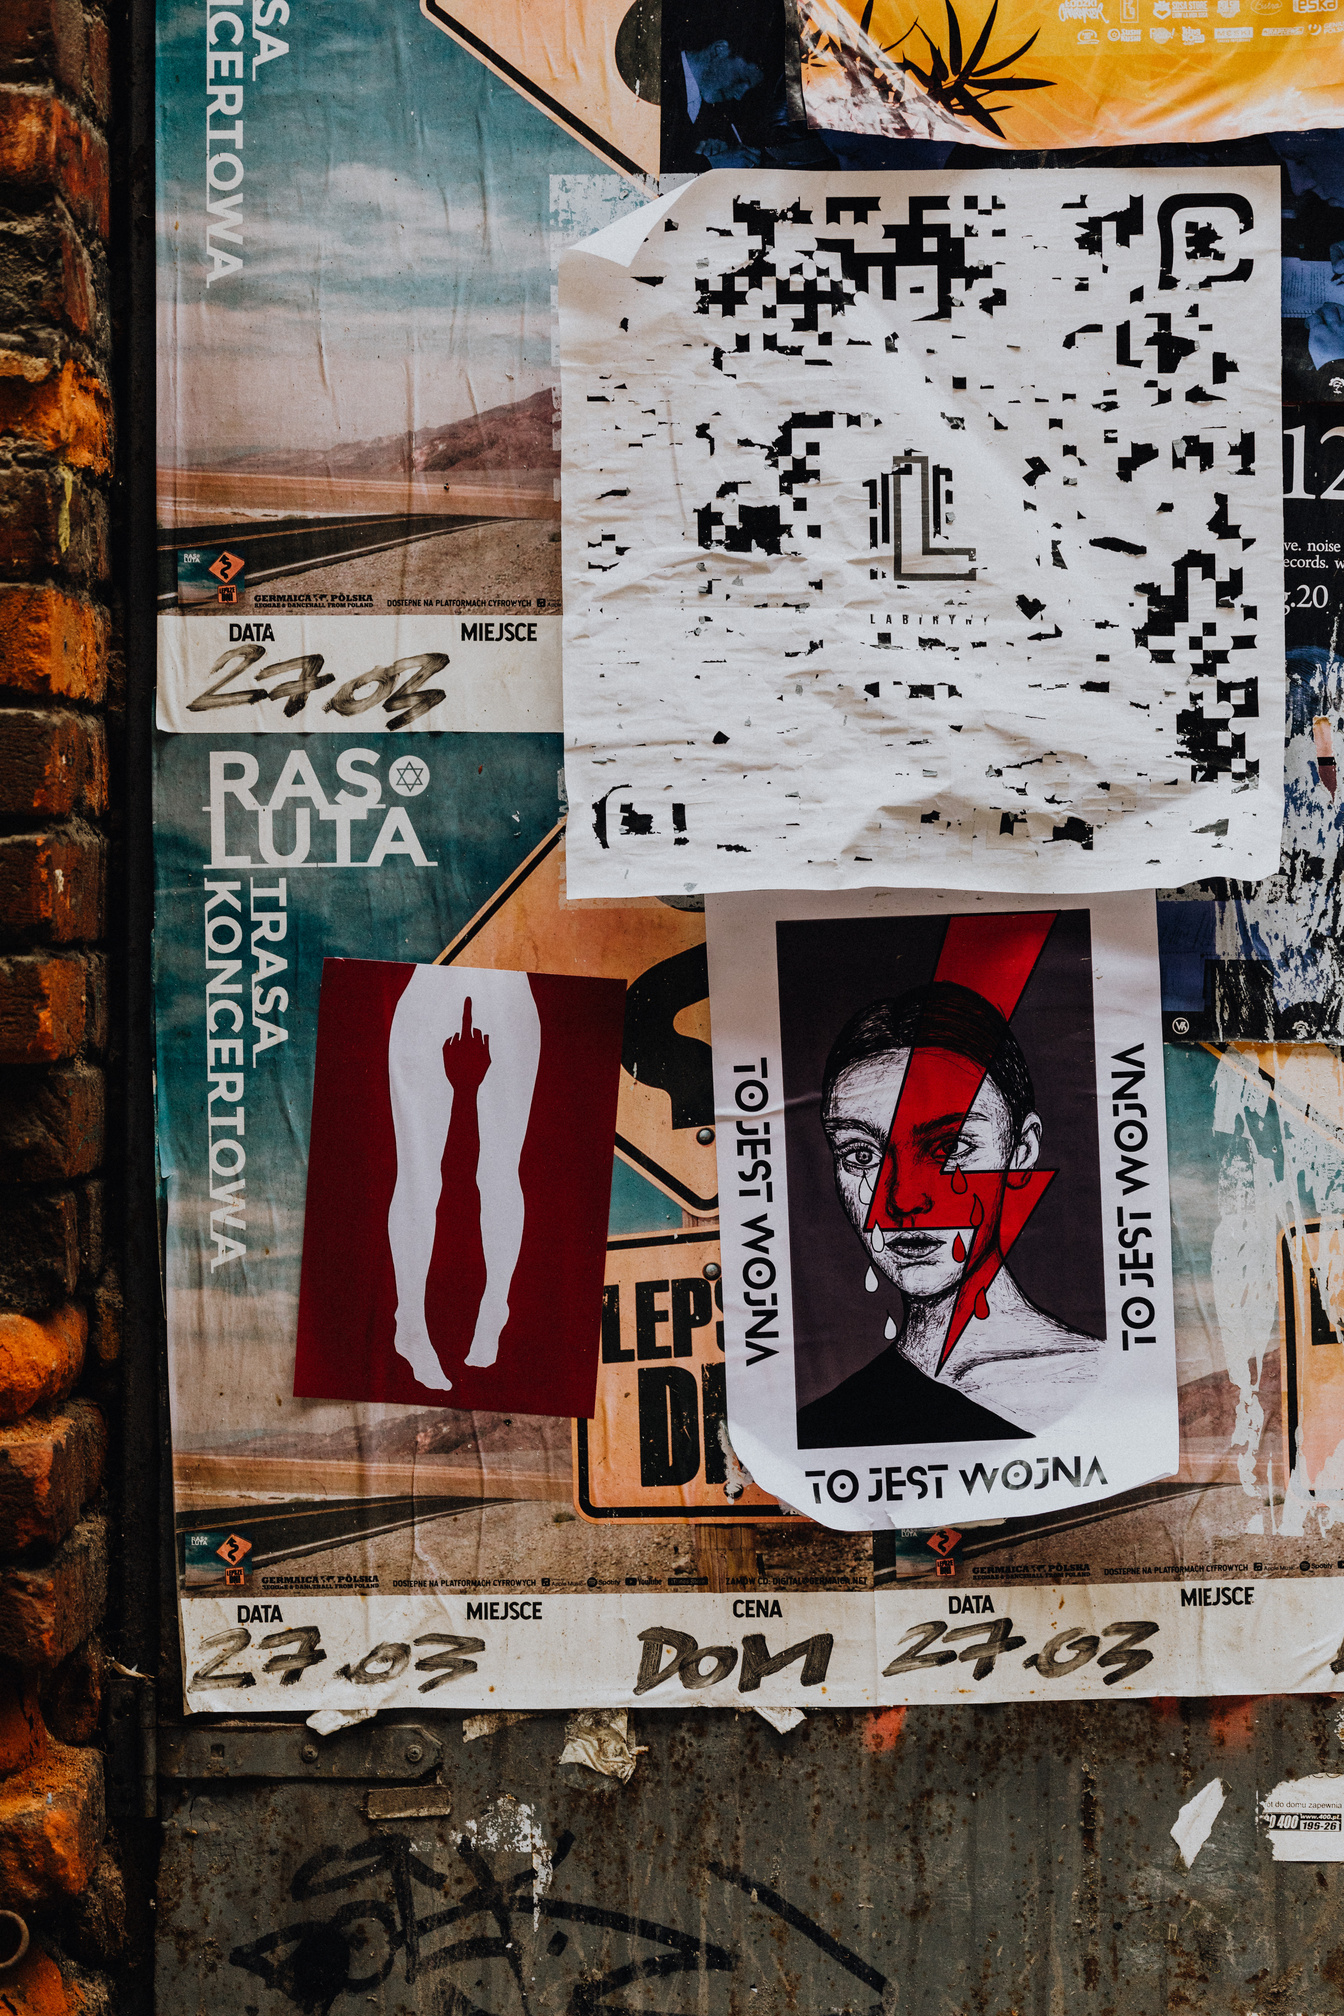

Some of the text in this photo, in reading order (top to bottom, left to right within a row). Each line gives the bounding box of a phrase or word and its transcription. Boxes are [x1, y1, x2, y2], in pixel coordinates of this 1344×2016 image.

[1307, 542, 1341, 552] noise
[254, 594, 311, 602] GERMAICA
[423, 599, 433, 607] NA
[435, 599, 486, 607] PLATFORMACH
[488, 599, 531, 607] CYFROWYCH
[229, 623, 275, 642] DATA
[461, 622, 538, 642] MIEJSCE
[206, 747, 383, 811] RAS
[203, 806, 438, 869] LUTA
[250, 877, 289, 1068] TRASA
[204, 878, 247, 1274] KONCERTOWA
[1110, 1042, 1157, 1351] TO JEST WOJNA
[733, 1056, 780, 1367] TO JEST WOJNA
[602, 1278, 725, 1364] LEP
[805, 1455, 1109, 1504] TO JEST WOJNA
[972, 1565, 1029, 1575] GERMAICA
[1142, 1566, 1152, 1575] NA
[1154, 1564, 1205, 1574] PLATFORMACH
[1206, 1563, 1249, 1572] CYFROWYCH
[429, 1579, 438, 1587] NA
[440, 1579, 491, 1587] PLATFORMACH
[492, 1578, 536, 1587] CYFROWYCH
[637, 1576, 662, 1585] YouTube
[948, 1594, 995, 1615] DATA
[1180, 1586, 1255, 1607] MIEJSCE
[237, 1604, 283, 1624] DATA
[466, 1601, 543, 1621] MIEJSCE
[732, 1599, 783, 1618] CENA
[633, 1626, 834, 1696] DOM
[1275, 1800, 1284, 1808] do
[1286, 1800, 1307, 1808] domu
[1308, 1802, 1342, 1810] zapewnia
[1277, 1815, 1299, 1829] 400
